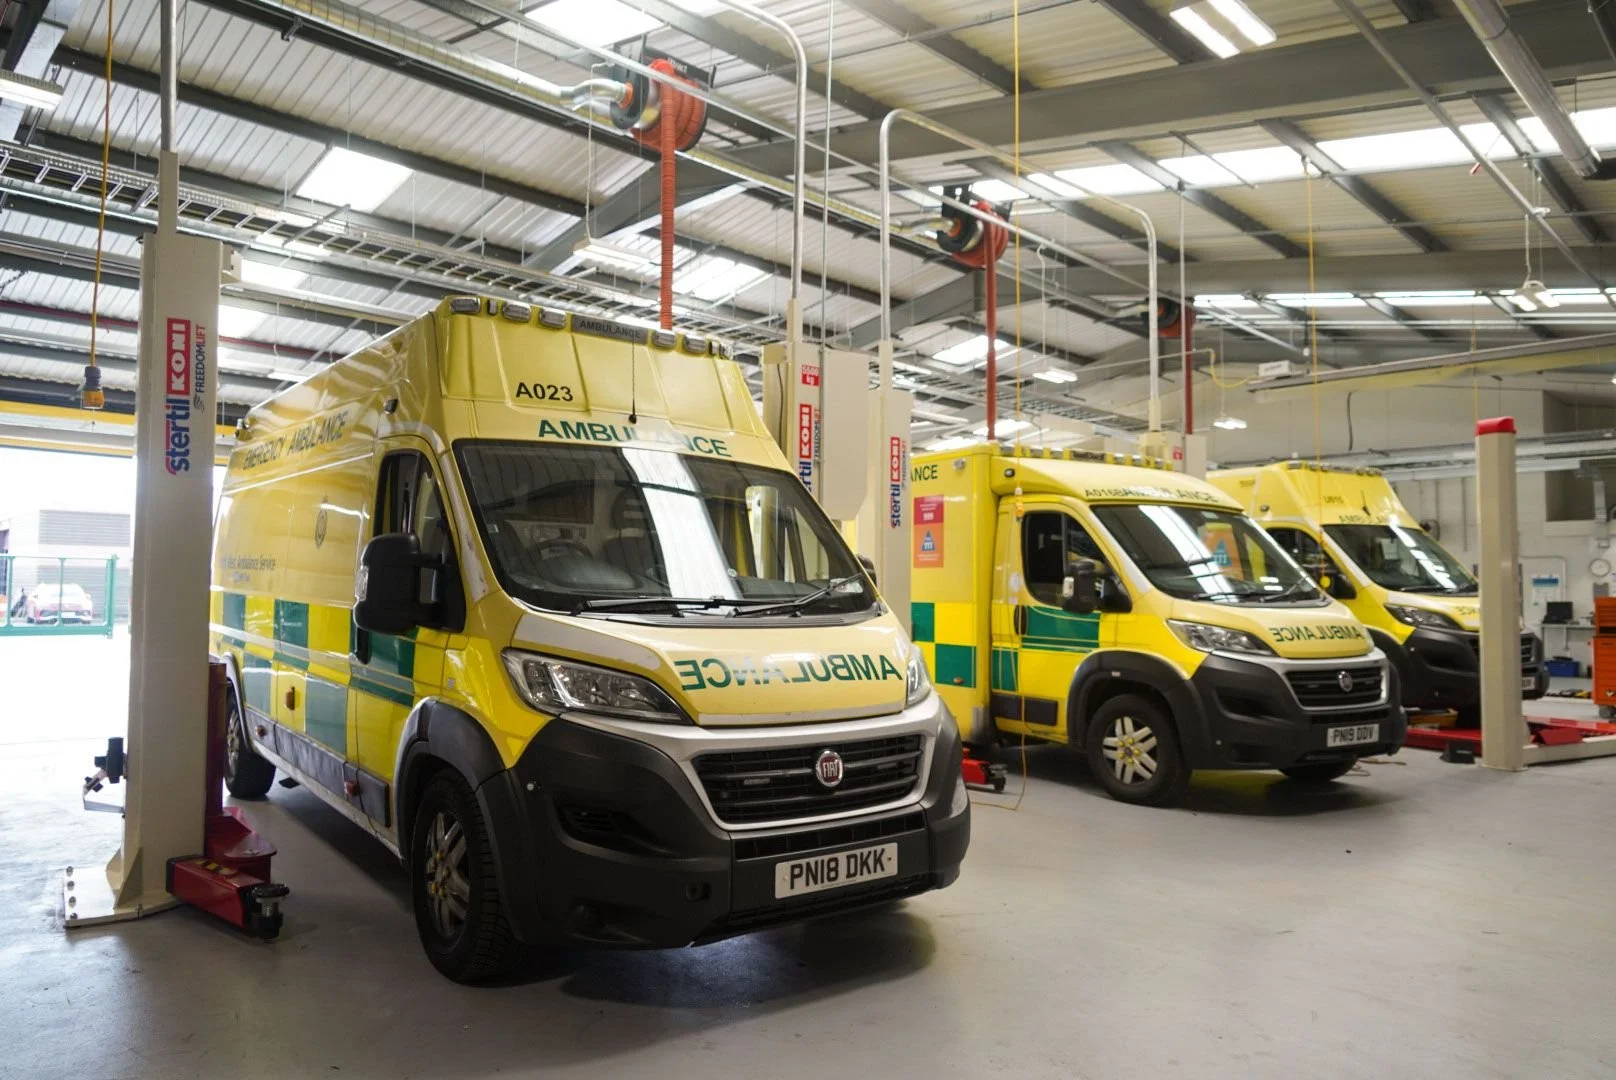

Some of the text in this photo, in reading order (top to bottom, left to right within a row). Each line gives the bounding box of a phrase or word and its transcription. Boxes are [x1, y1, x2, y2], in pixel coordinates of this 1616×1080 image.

[579, 319, 641, 339] AMBULANCE
[195, 324, 206, 393] FREEDOMLIFT
[166, 321, 190, 475] stertil KONI
[515, 382, 573, 402] A023
[801, 405, 811, 458] KONI
[890, 438, 900, 529] stertil KONI
[822, 759, 839, 778] FIAT
[789, 848, 886, 890] PN18 DKK
